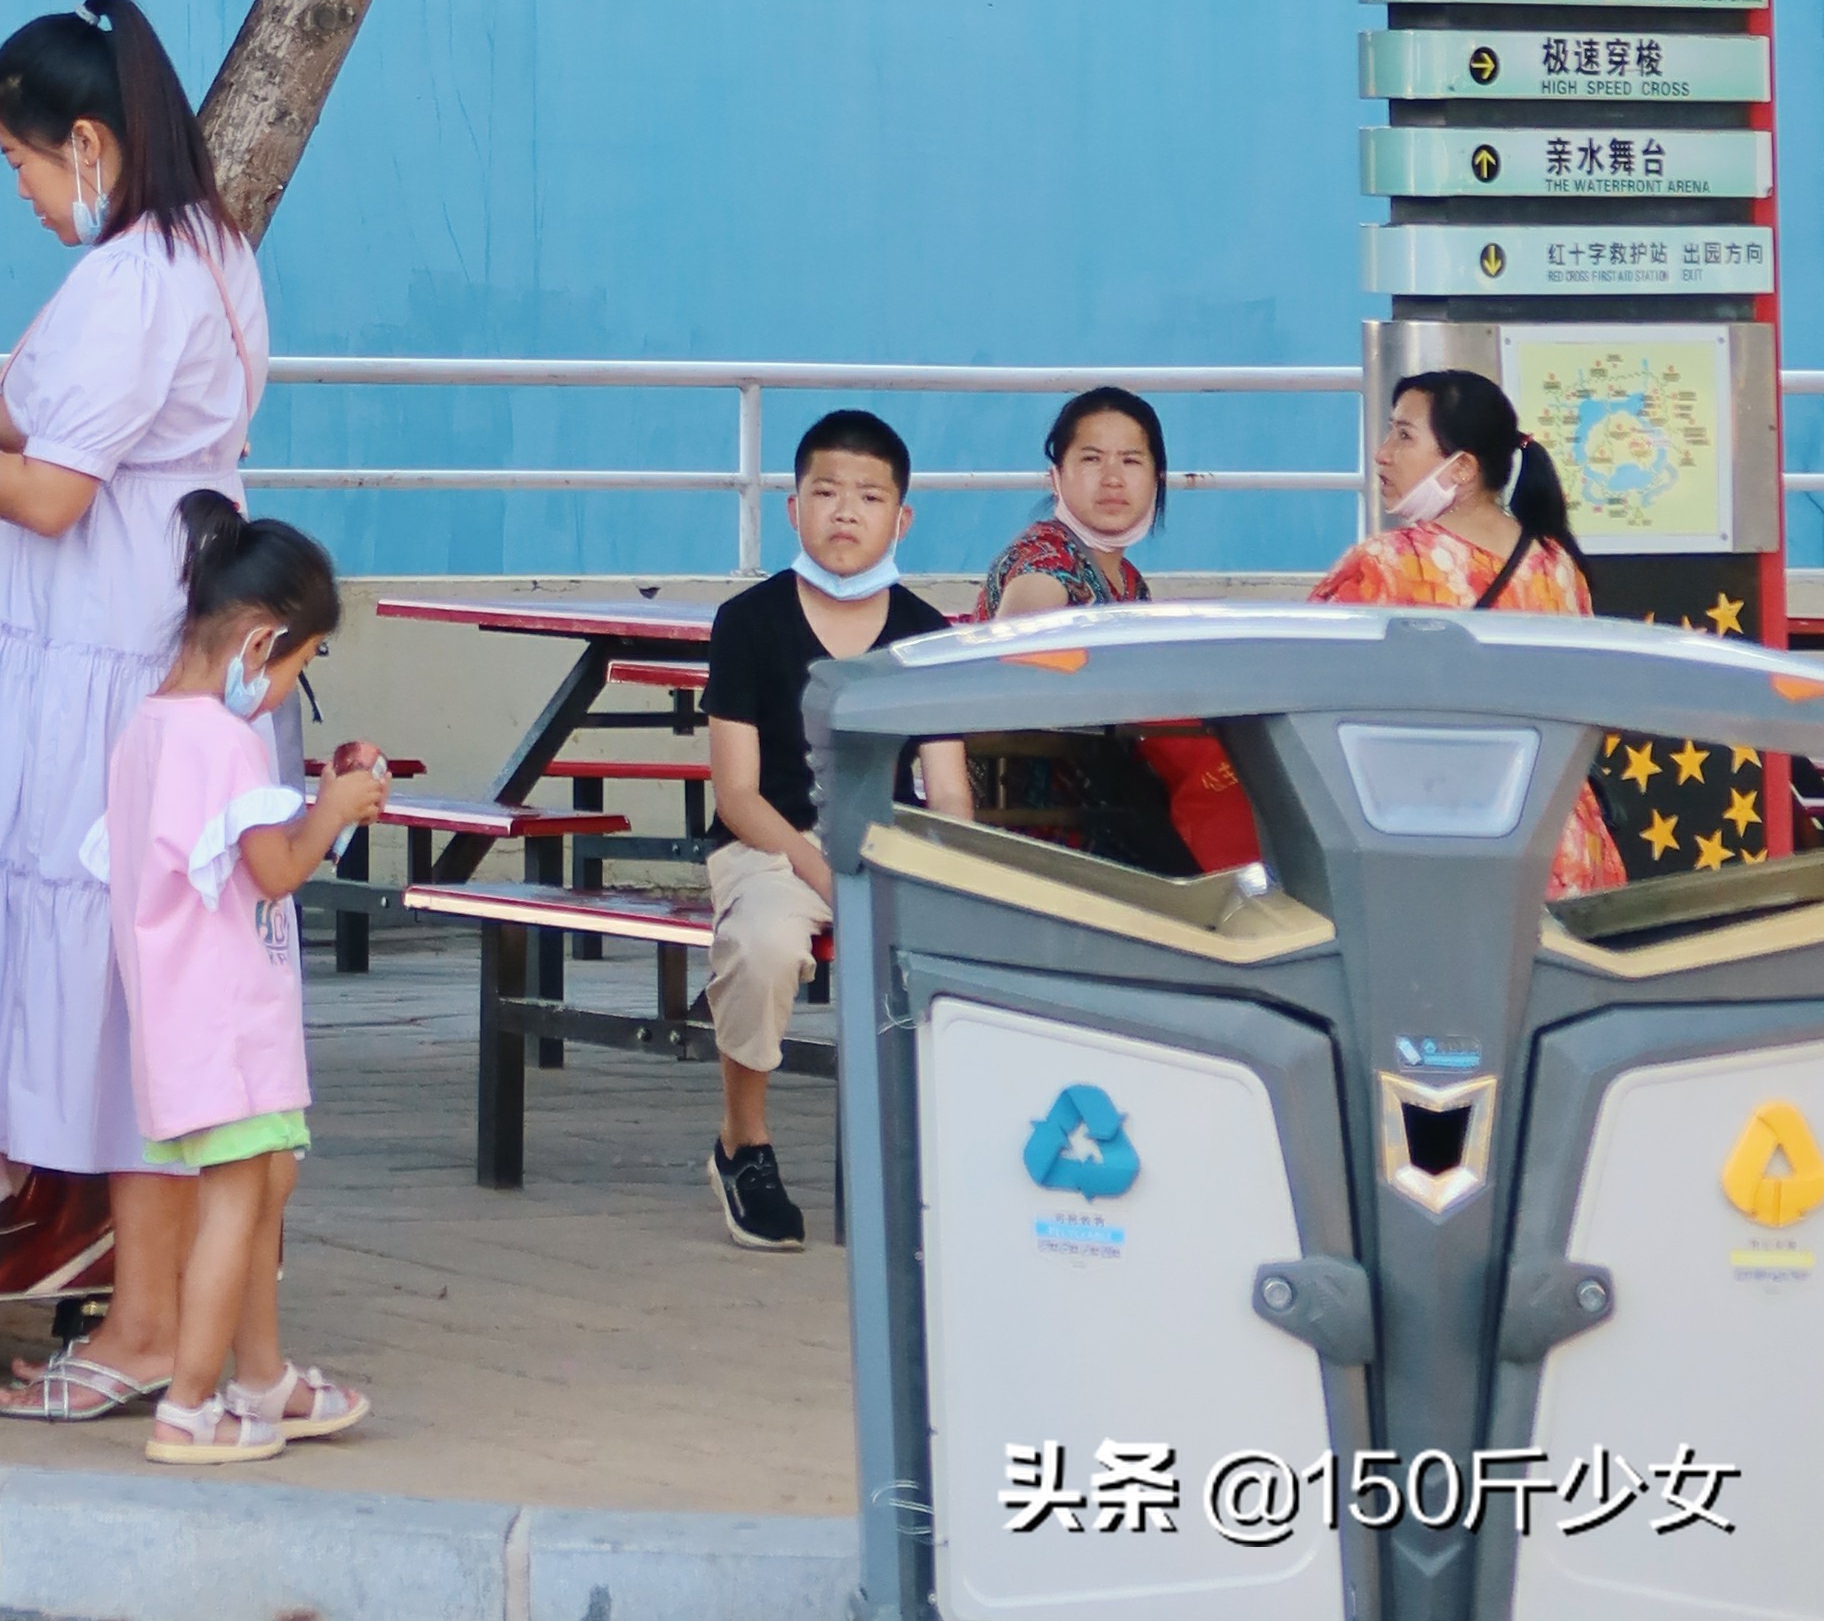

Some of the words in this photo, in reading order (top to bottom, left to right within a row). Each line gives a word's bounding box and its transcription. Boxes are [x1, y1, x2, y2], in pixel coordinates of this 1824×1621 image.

[1542, 37, 1664, 77] 极速穿梭
[1541, 80, 1577, 95] HIGH
[1587, 81, 1632, 96] SPEED
[1642, 82, 1691, 97] CROSS
[1546, 137, 1666, 177] 亲水舞台
[1546, 179, 1569, 193] THE
[1575, 179, 1663, 193] WATERFRONT
[1667, 180, 1711, 194] ARENA
[1547, 242, 1669, 266] 红十字救护站
[1683, 242, 1764, 265] 出园方向
[1547, 270, 1564, 282] RED
[1591, 270, 1617, 282] FIRST
[1683, 269, 1704, 282] EXIT
